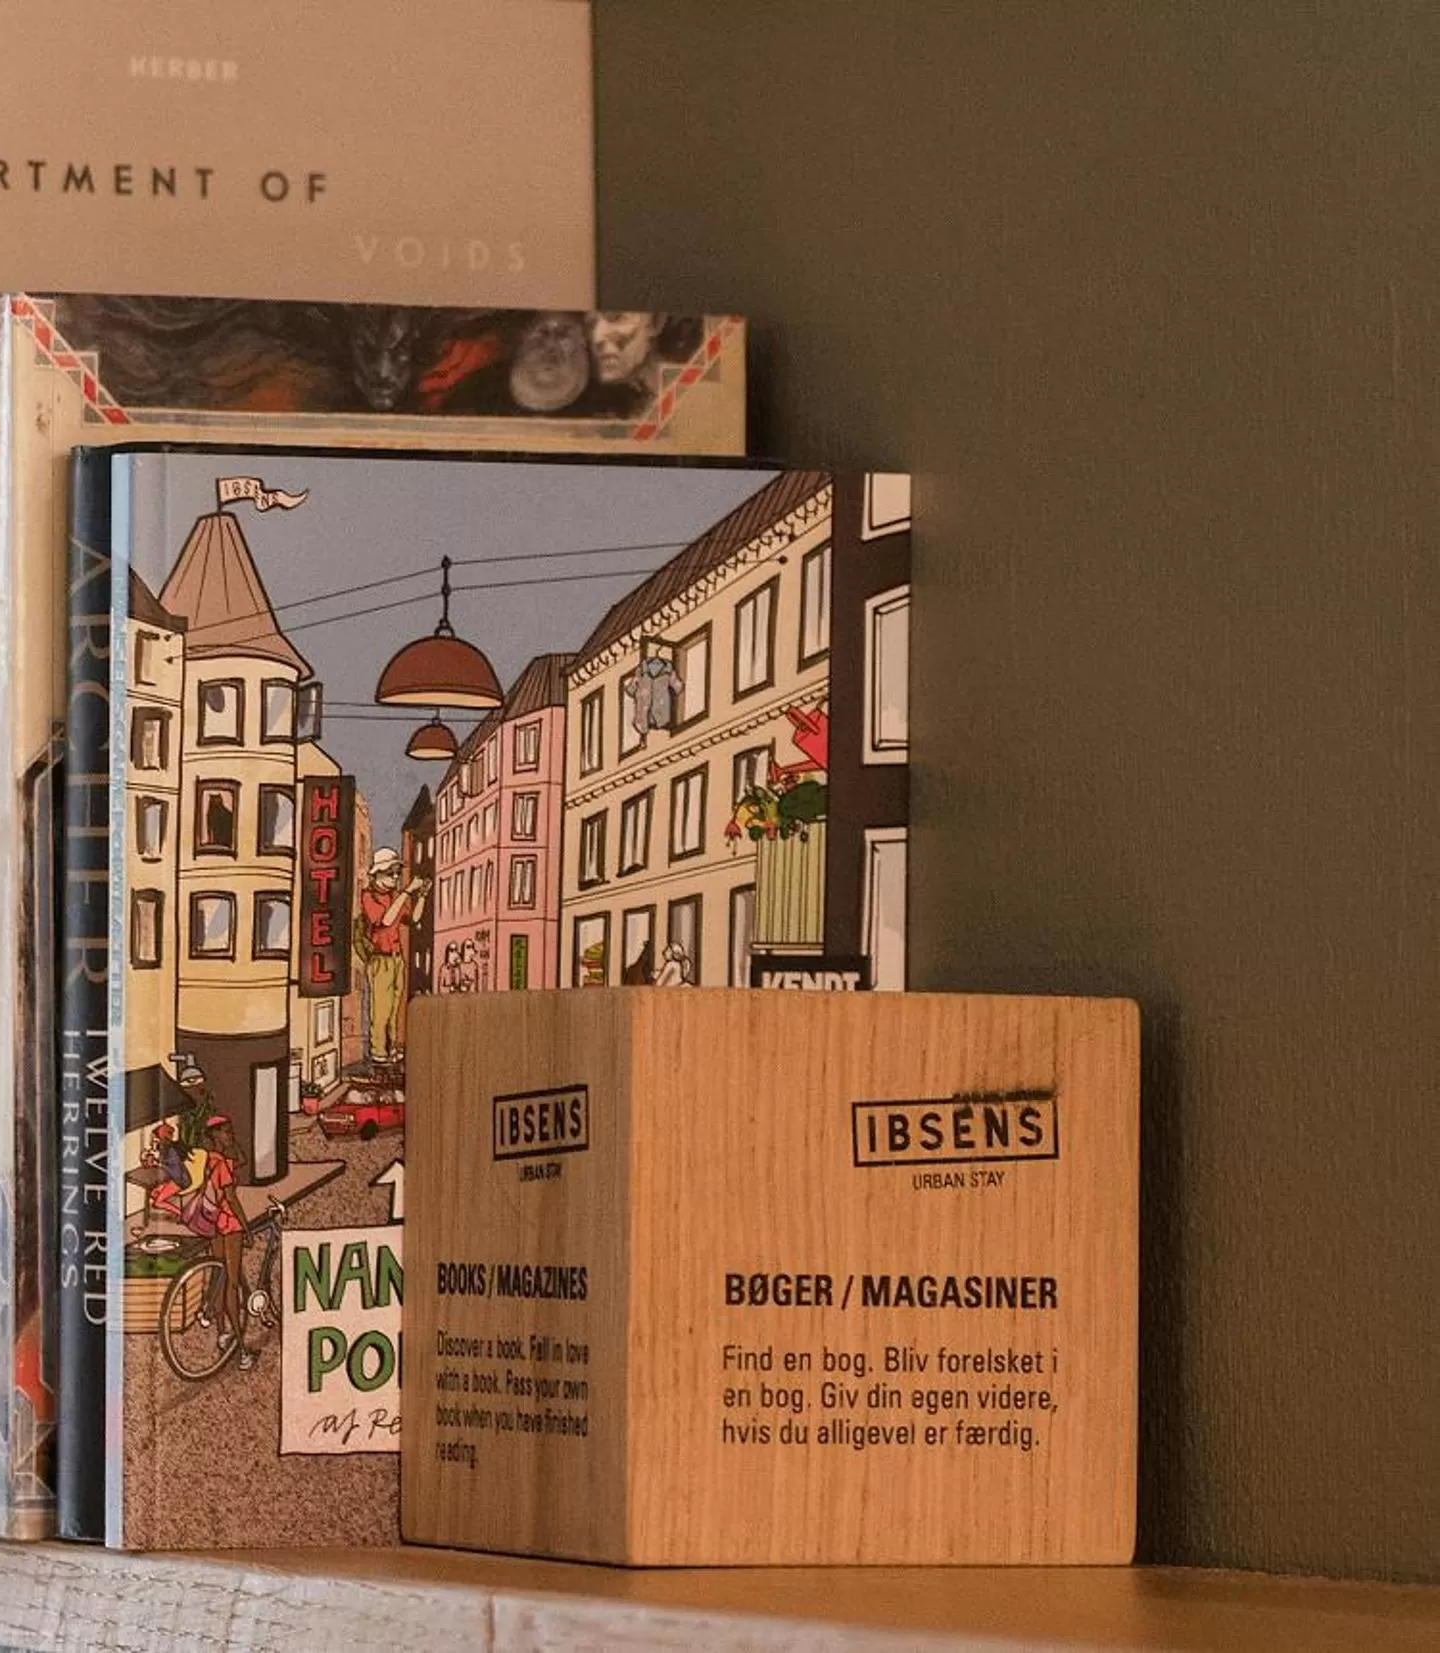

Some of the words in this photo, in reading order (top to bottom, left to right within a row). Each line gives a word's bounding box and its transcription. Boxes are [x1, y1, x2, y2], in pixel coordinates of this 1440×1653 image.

[130, 55, 240, 81] KERBER
[260, 170, 328, 202] OF
[355, 234, 527, 272] VOIDS
[310, 785, 339, 985] HOTEL
[499, 1097, 582, 1147] IBSENS
[867, 1106, 1044, 1152] IBSENS
[62, 1030, 81, 1290] HERRINGS
[912, 1173, 965, 1190] URBAN
[971, 1171, 1005, 1189] STAY
[84, 1230, 108, 1326] RED
[436, 1262, 486, 1296] BOOKS
[496, 1264, 589, 1301] MAGAZINES
[724, 1273, 834, 1307] BØGER
[861, 1274, 1058, 1309] MAGASINER
[308, 1326, 402, 1393] PO
[436, 1330, 485, 1357] Discover
[496, 1334, 525, 1360] book.
[529, 1333, 550, 1362] Fall
[566, 1337, 589, 1365] love
[722, 1346, 773, 1371] Find
[783, 1352, 811, 1371] en
[822, 1347, 873, 1377] bog.
[884, 1347, 929, 1372] Bliv
[937, 1348, 1044, 1373] forelsket
[1051, 1348, 1058, 1373] i
[506, 1369, 533, 1397] Pass
[723, 1387, 751, 1408] en
[760, 1382, 811, 1413] bog.
[821, 1382, 859, 1409] Giv
[866, 1383, 902, 1409] din
[911, 1388, 968, 1414] egen
[977, 1383, 1059, 1413] videre,
[516, 1404, 542, 1433] have
[723, 1419, 771, 1445] hvis
[780, 1419, 808, 1445] du
[817, 1419, 915, 1450] alligevel
[924, 1425, 947, 1446] er
[956, 1419, 1040, 1451] færdig.
